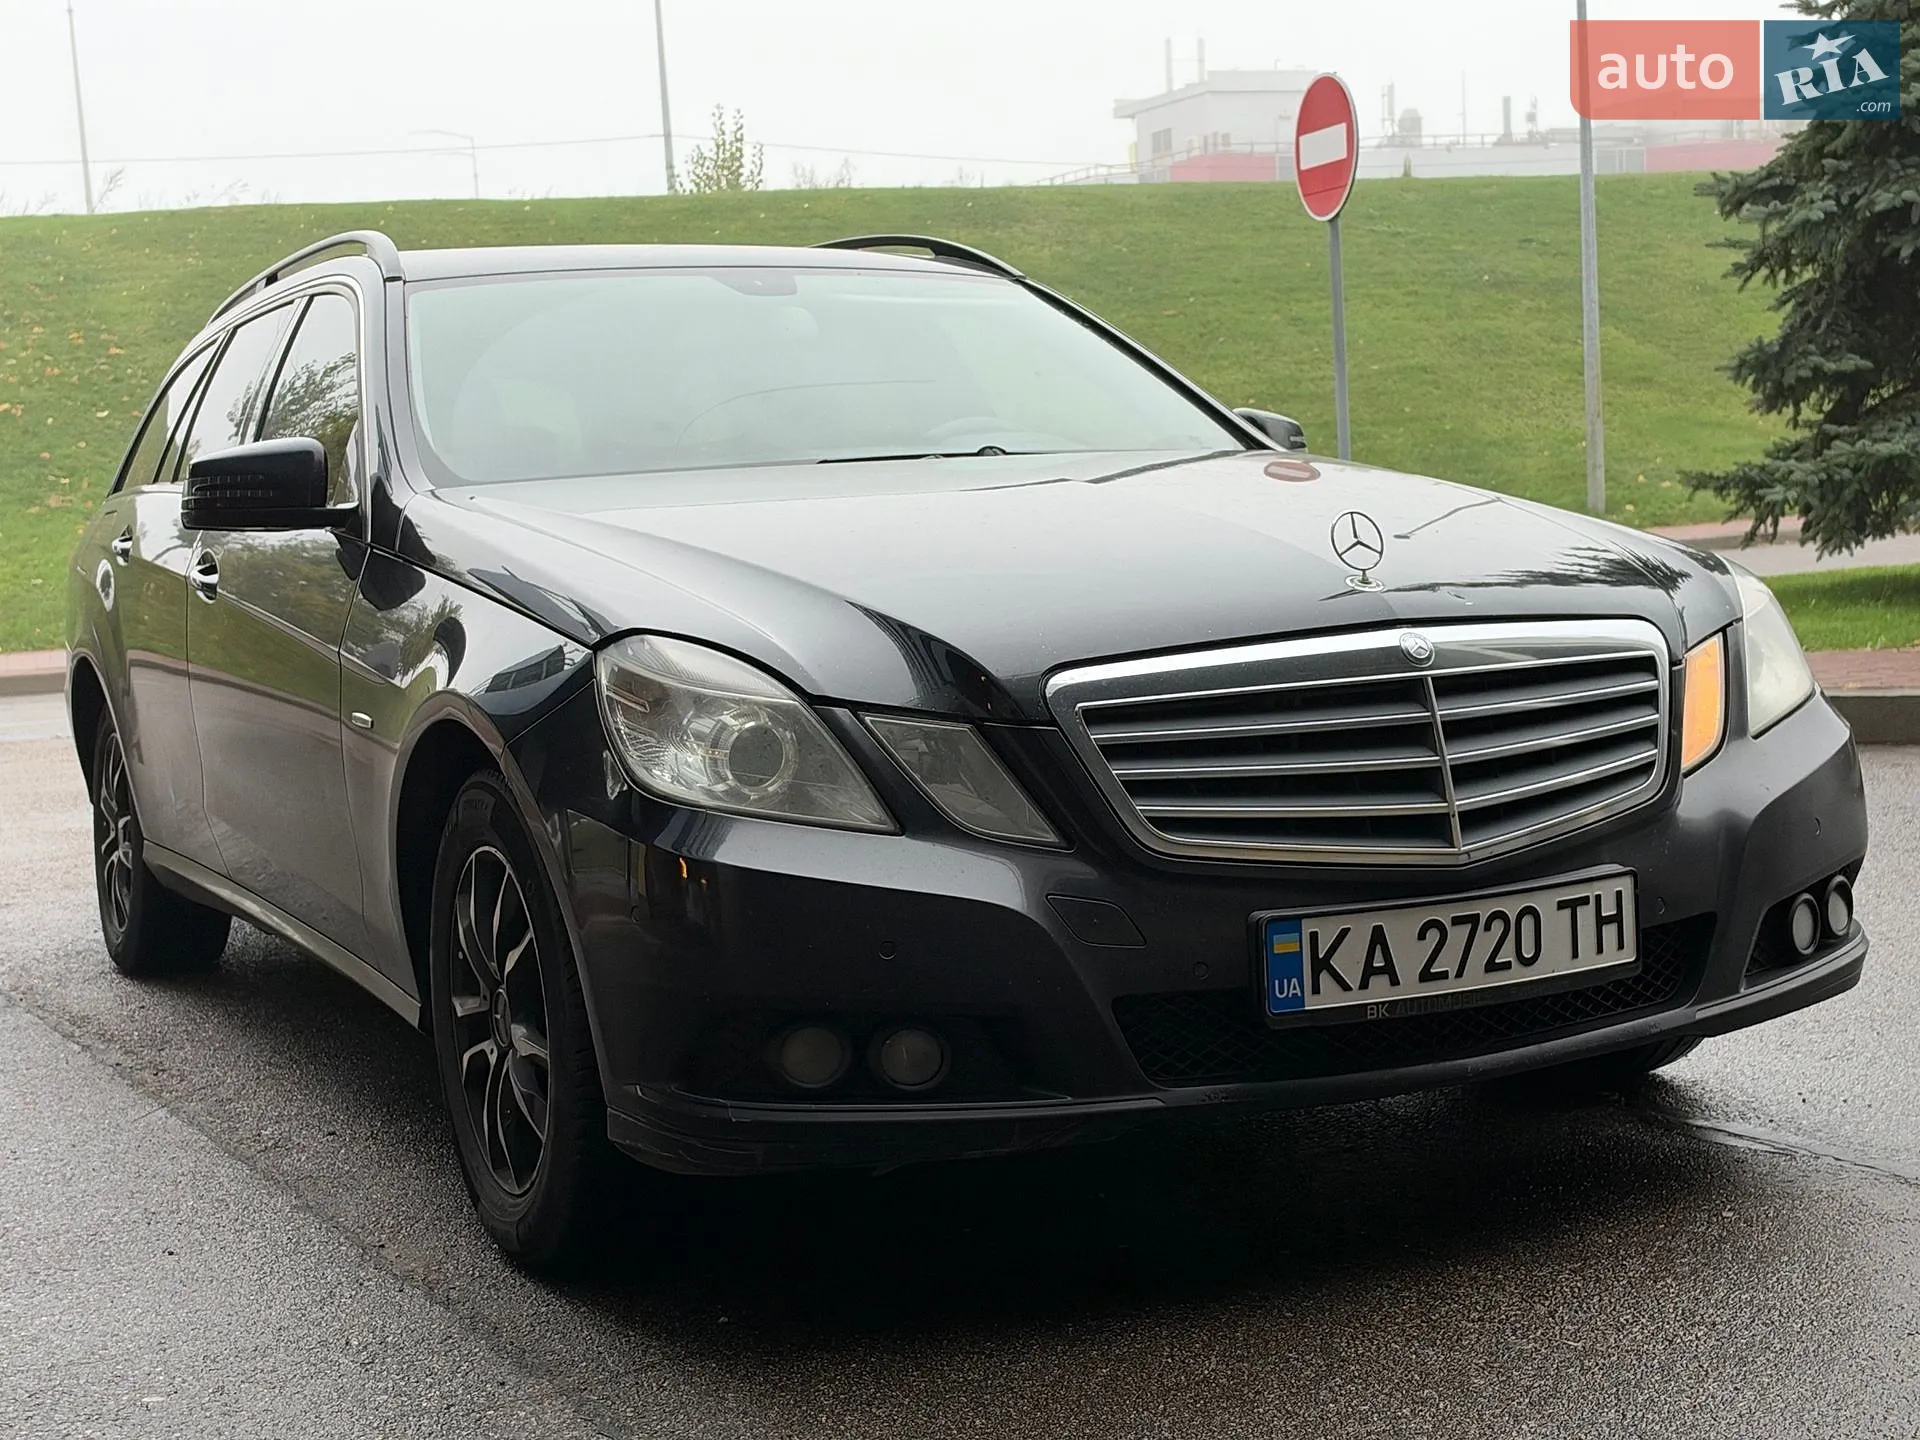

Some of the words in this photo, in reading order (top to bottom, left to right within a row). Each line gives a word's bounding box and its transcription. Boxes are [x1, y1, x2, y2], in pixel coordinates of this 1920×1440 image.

[1308, 924, 1401, 995] KA
[1416, 904, 1542, 983] 2720
[1556, 888, 1625, 960] TH
[1274, 978, 1302, 999] UA
